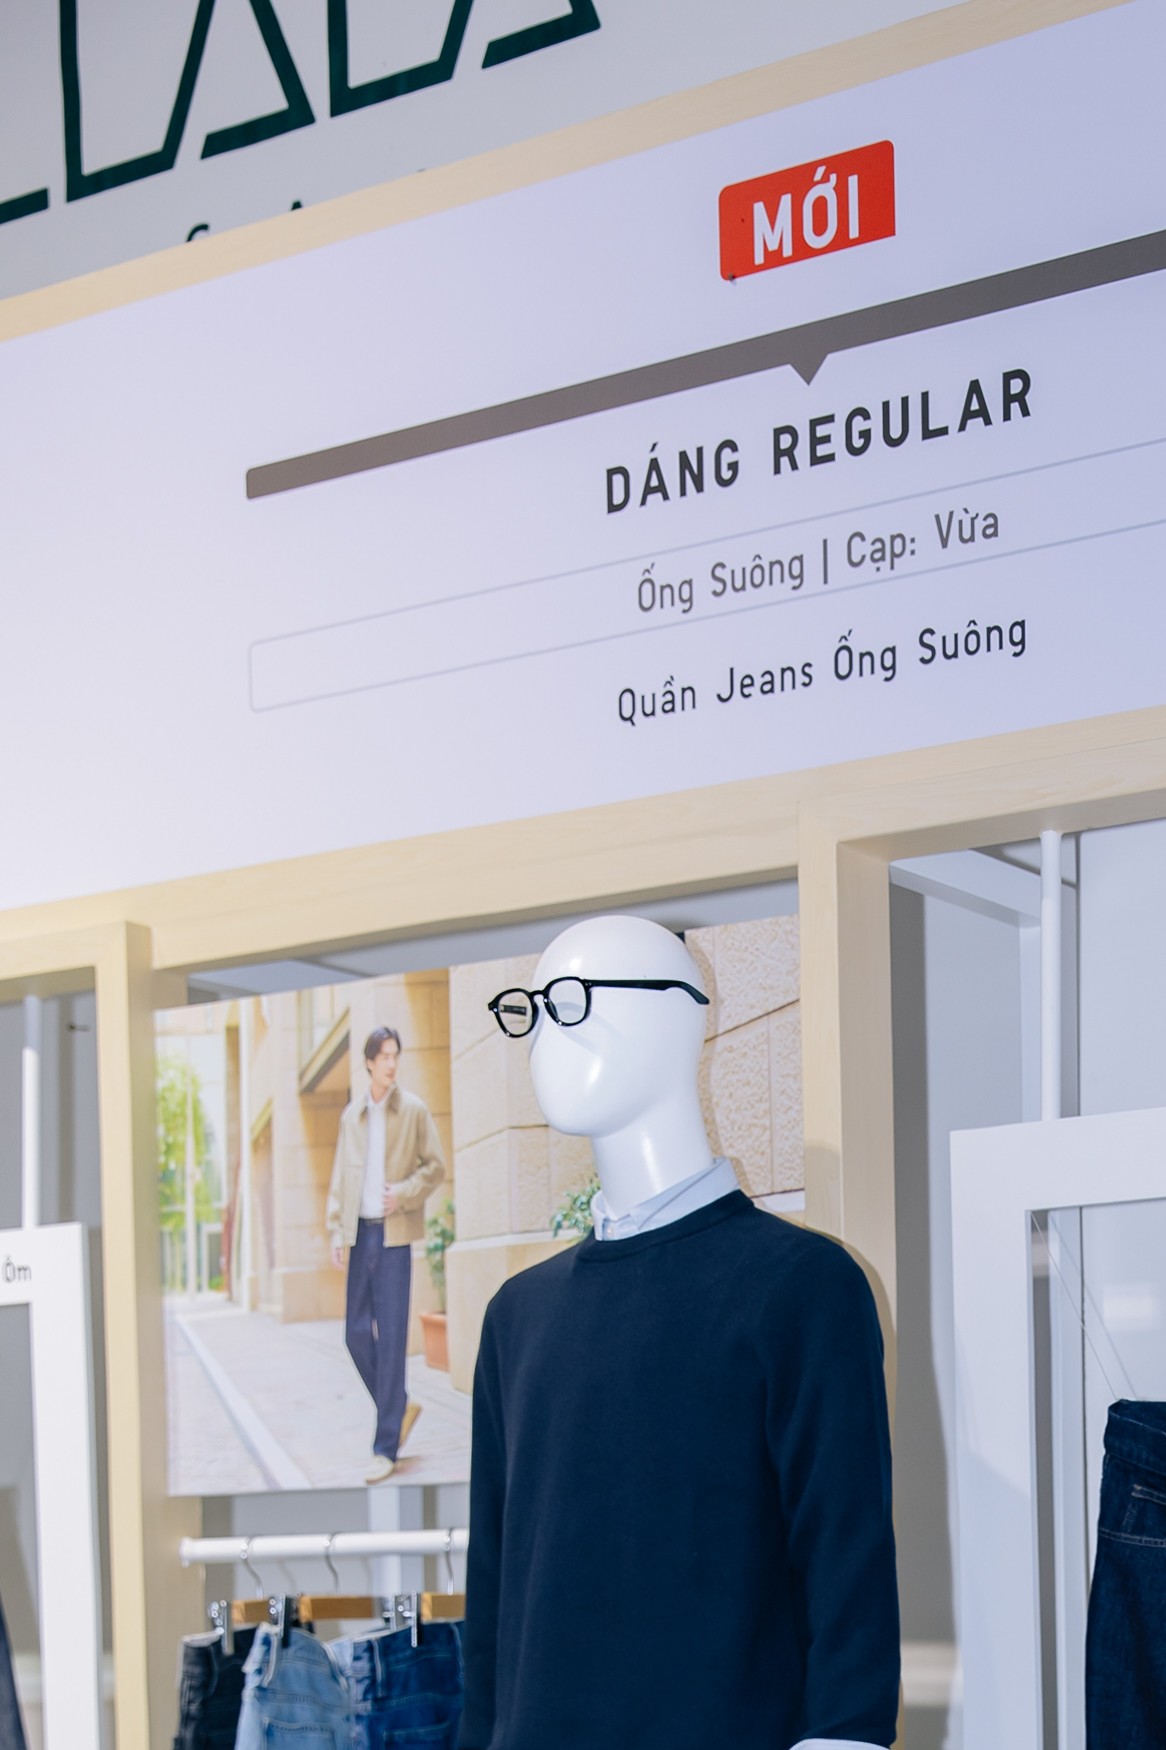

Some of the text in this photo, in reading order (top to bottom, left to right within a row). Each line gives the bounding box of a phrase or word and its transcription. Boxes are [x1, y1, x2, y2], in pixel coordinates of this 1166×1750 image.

[753, 165, 859, 266] MỚI
[606, 368, 1032, 515] DÁNG REGULAR
[637, 561, 694, 614] Ống
[710, 553, 804, 598] Suông
[846, 531, 916, 573] Cạp:
[933, 507, 999, 550] Vừa
[617, 619, 1026, 727] Quần Jeans Ống Suông
